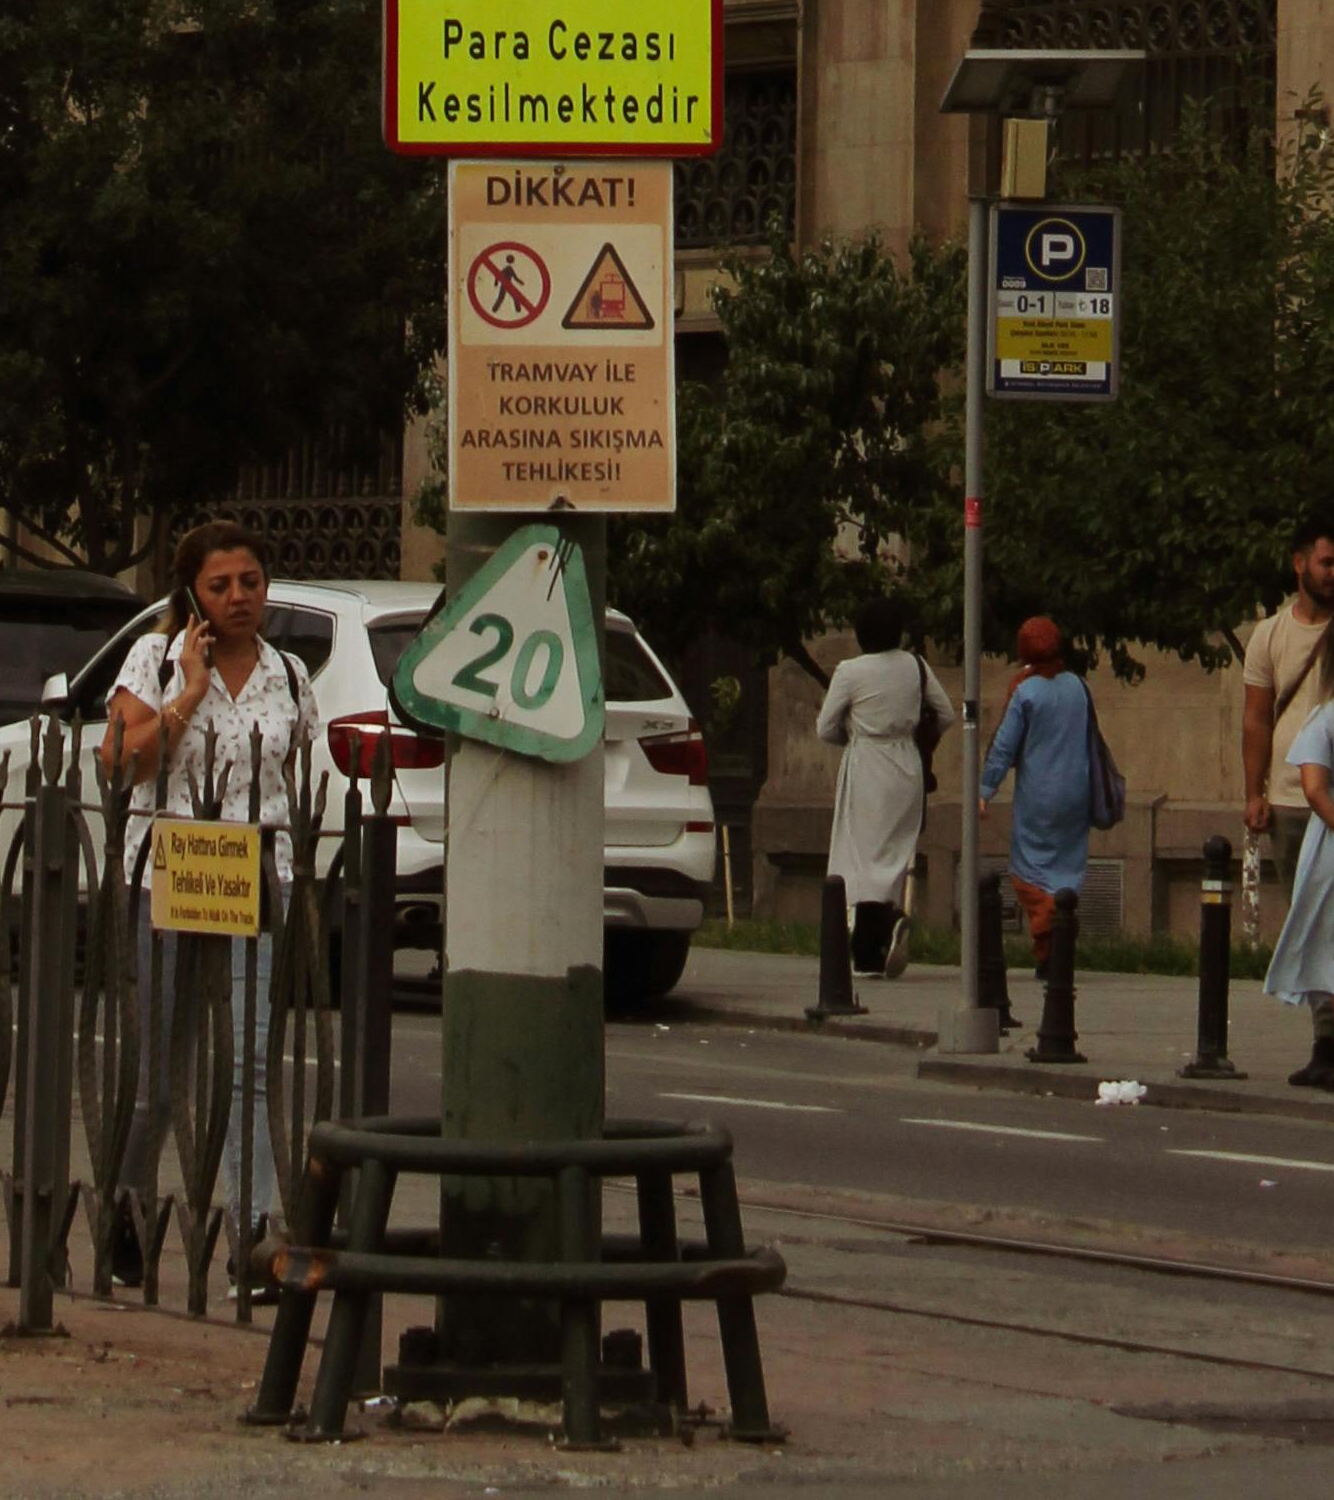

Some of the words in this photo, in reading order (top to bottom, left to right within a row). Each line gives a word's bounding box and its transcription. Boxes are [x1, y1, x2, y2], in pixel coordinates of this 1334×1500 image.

[443, 19, 530, 61] Para
[548, 20, 675, 61] Cezası
[418, 82, 699, 125] Kesilmektedir
[485, 169, 636, 208] DİKKAT!
[1089, 297, 1110, 314] 18
[487, 362, 598, 383] TRAMVAY
[604, 358, 636, 383] İLE
[499, 396, 625, 417] KORKULUK
[460, 429, 562, 449] ARASINA
[568, 429, 665, 454] SIKIŞMA
[502, 457, 622, 483] TEHLİKESİ!
[451, 612, 564, 711] 20
[171, 832, 187, 860] Ray
